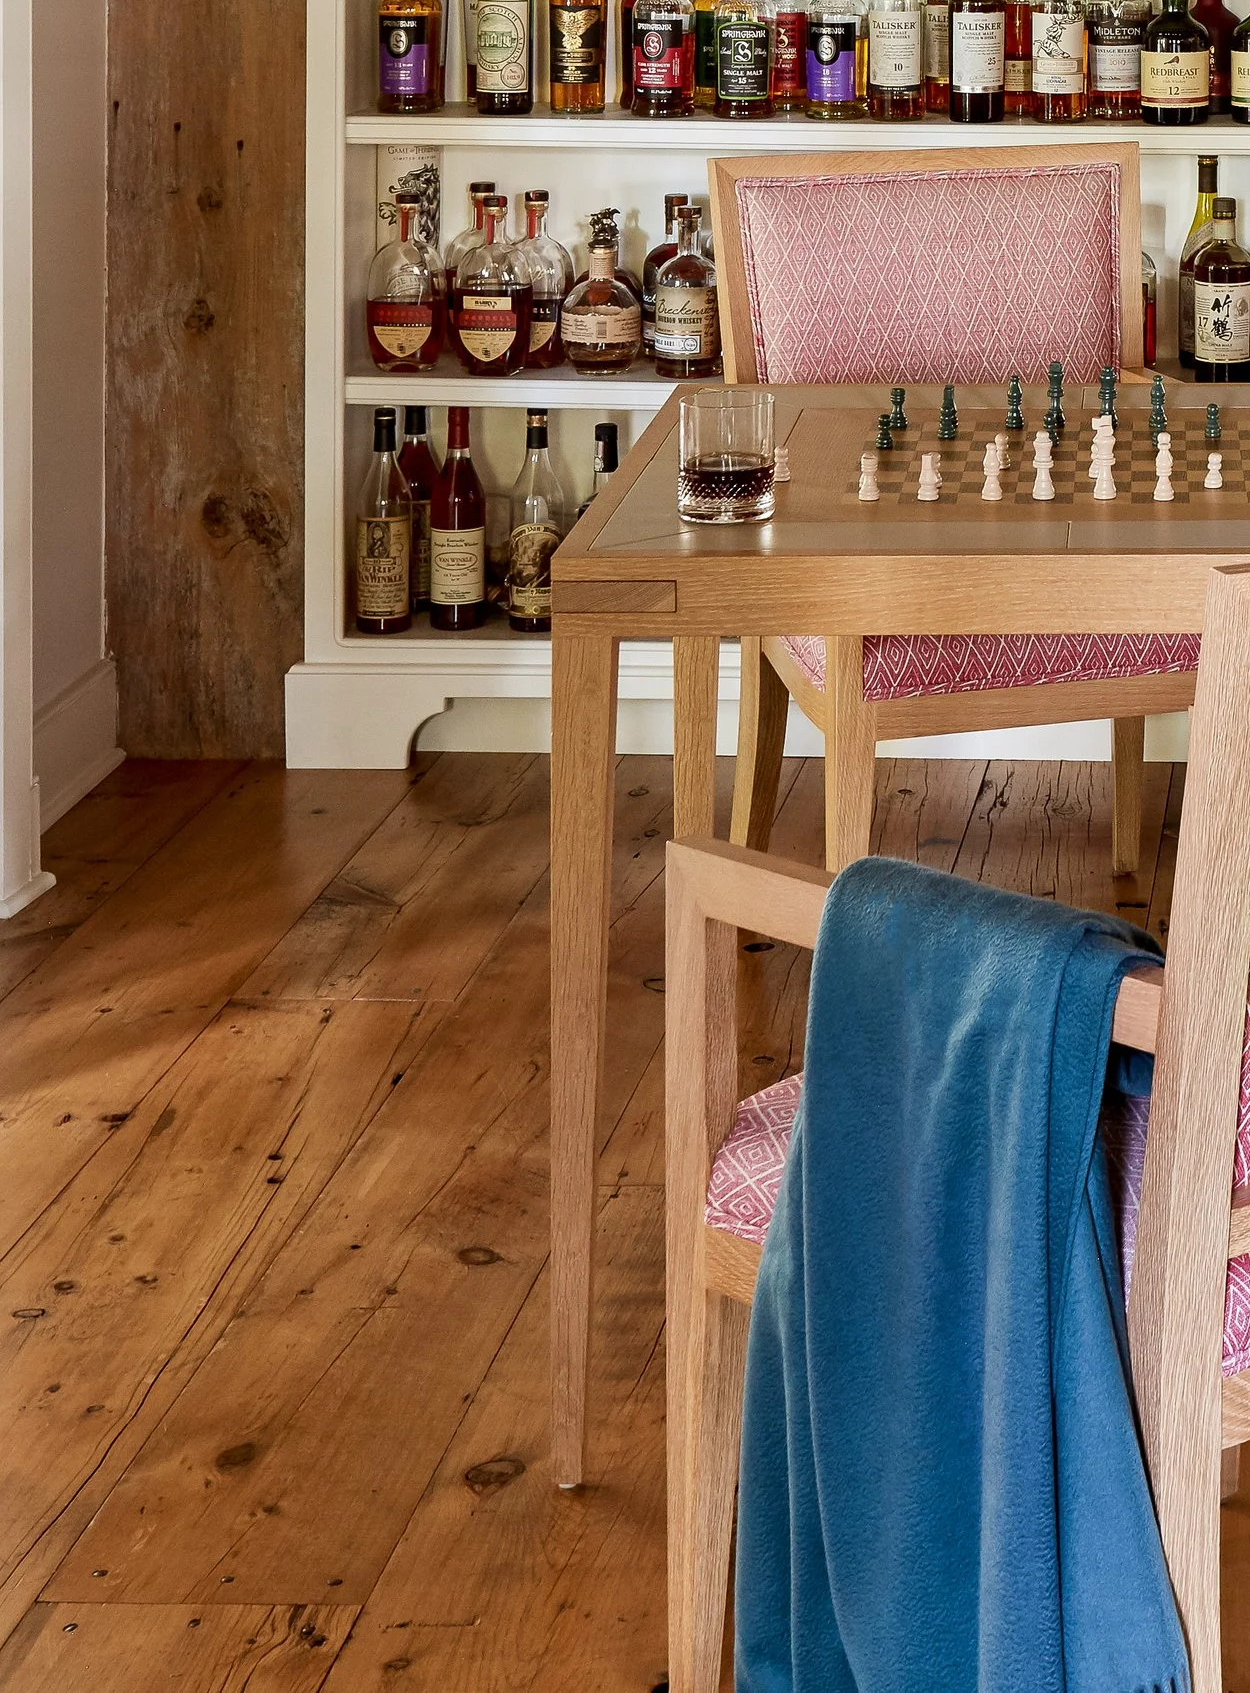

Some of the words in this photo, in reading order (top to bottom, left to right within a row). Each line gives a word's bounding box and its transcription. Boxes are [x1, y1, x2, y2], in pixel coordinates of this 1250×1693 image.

[489, 7, 518, 22] SCOTCH
[872, 20, 916, 29] TALISKER
[957, 22, 1001, 30] TALISKER
[722, 30, 766, 38] SPRINGBANK
[1094, 26, 1141, 36] MIDLETON
[987, 57, 996, 65] 25
[894, 63, 903, 71] 10
[1150, 67, 1199, 76] REDBREAST
[1168, 87, 1180, 95] 12
[1198, 316, 1209, 327] 17
